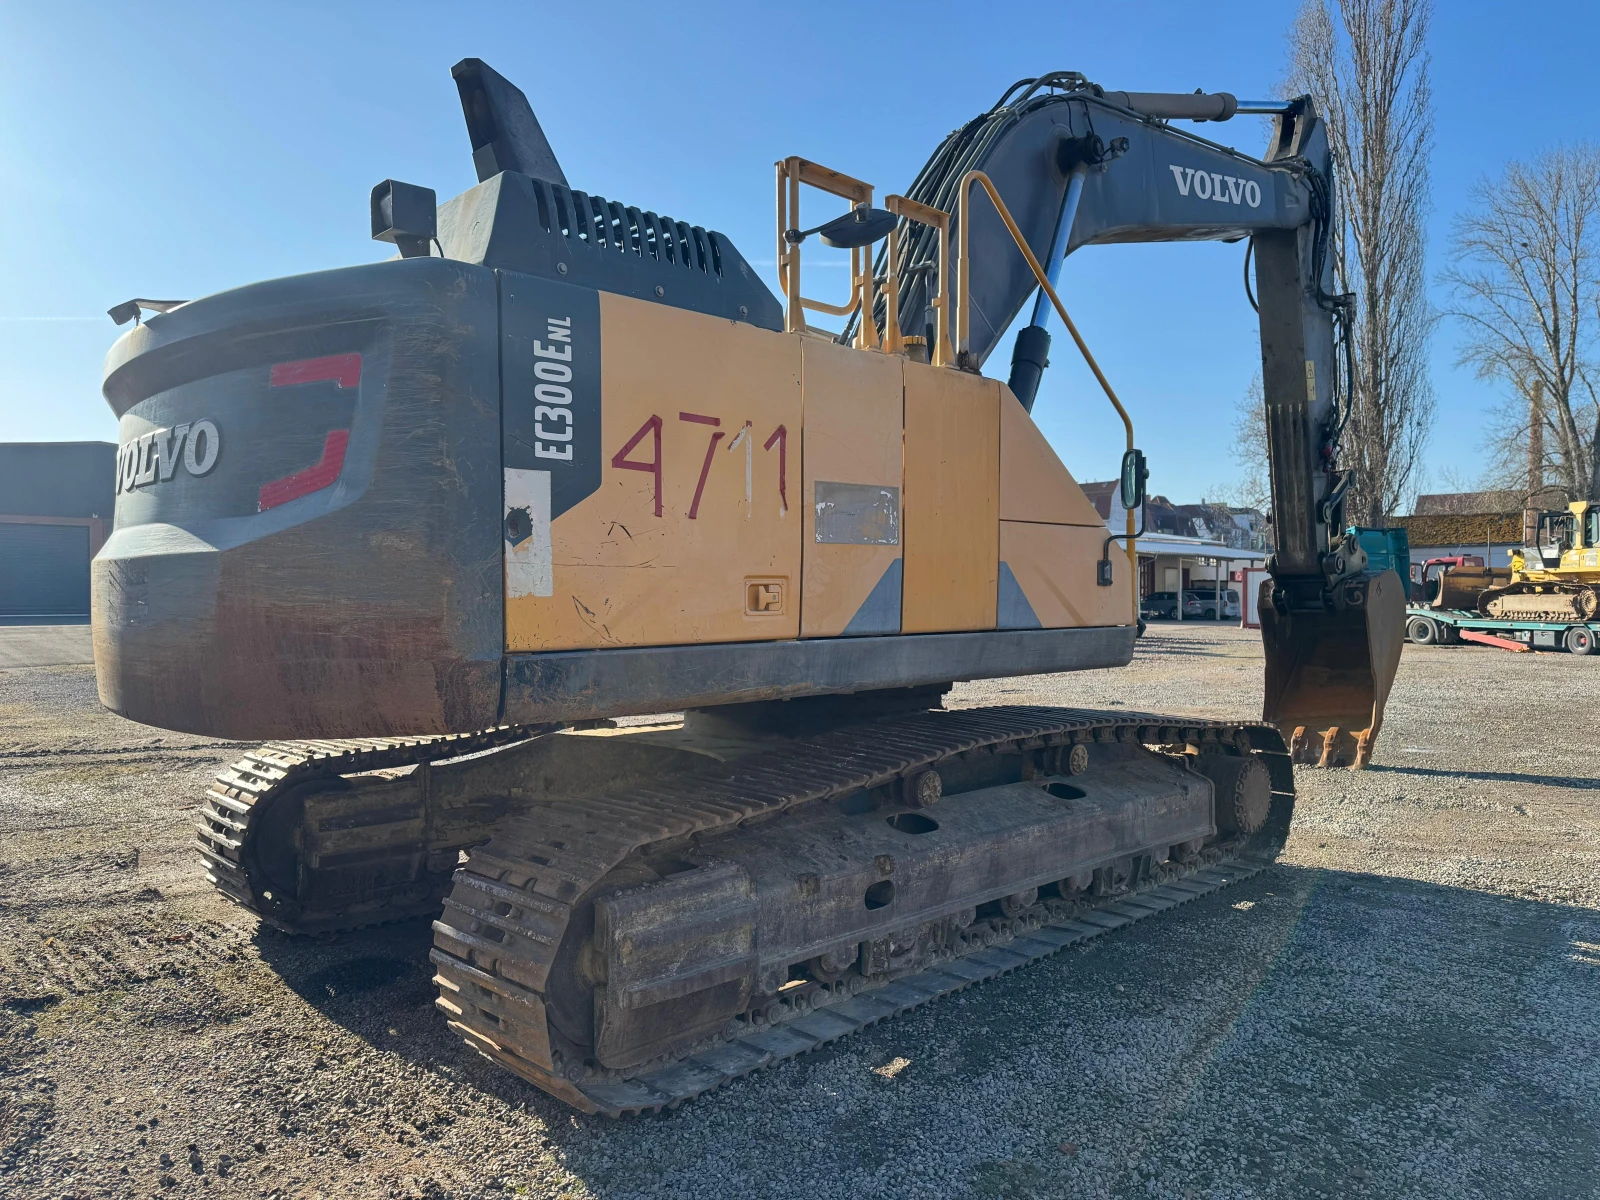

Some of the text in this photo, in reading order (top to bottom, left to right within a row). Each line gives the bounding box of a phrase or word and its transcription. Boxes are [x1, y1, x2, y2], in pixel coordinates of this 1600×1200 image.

[1169, 164, 1261, 208] VOLVO
[116, 418, 220, 496] VOLVO
[612, 411, 788, 519] 4711
